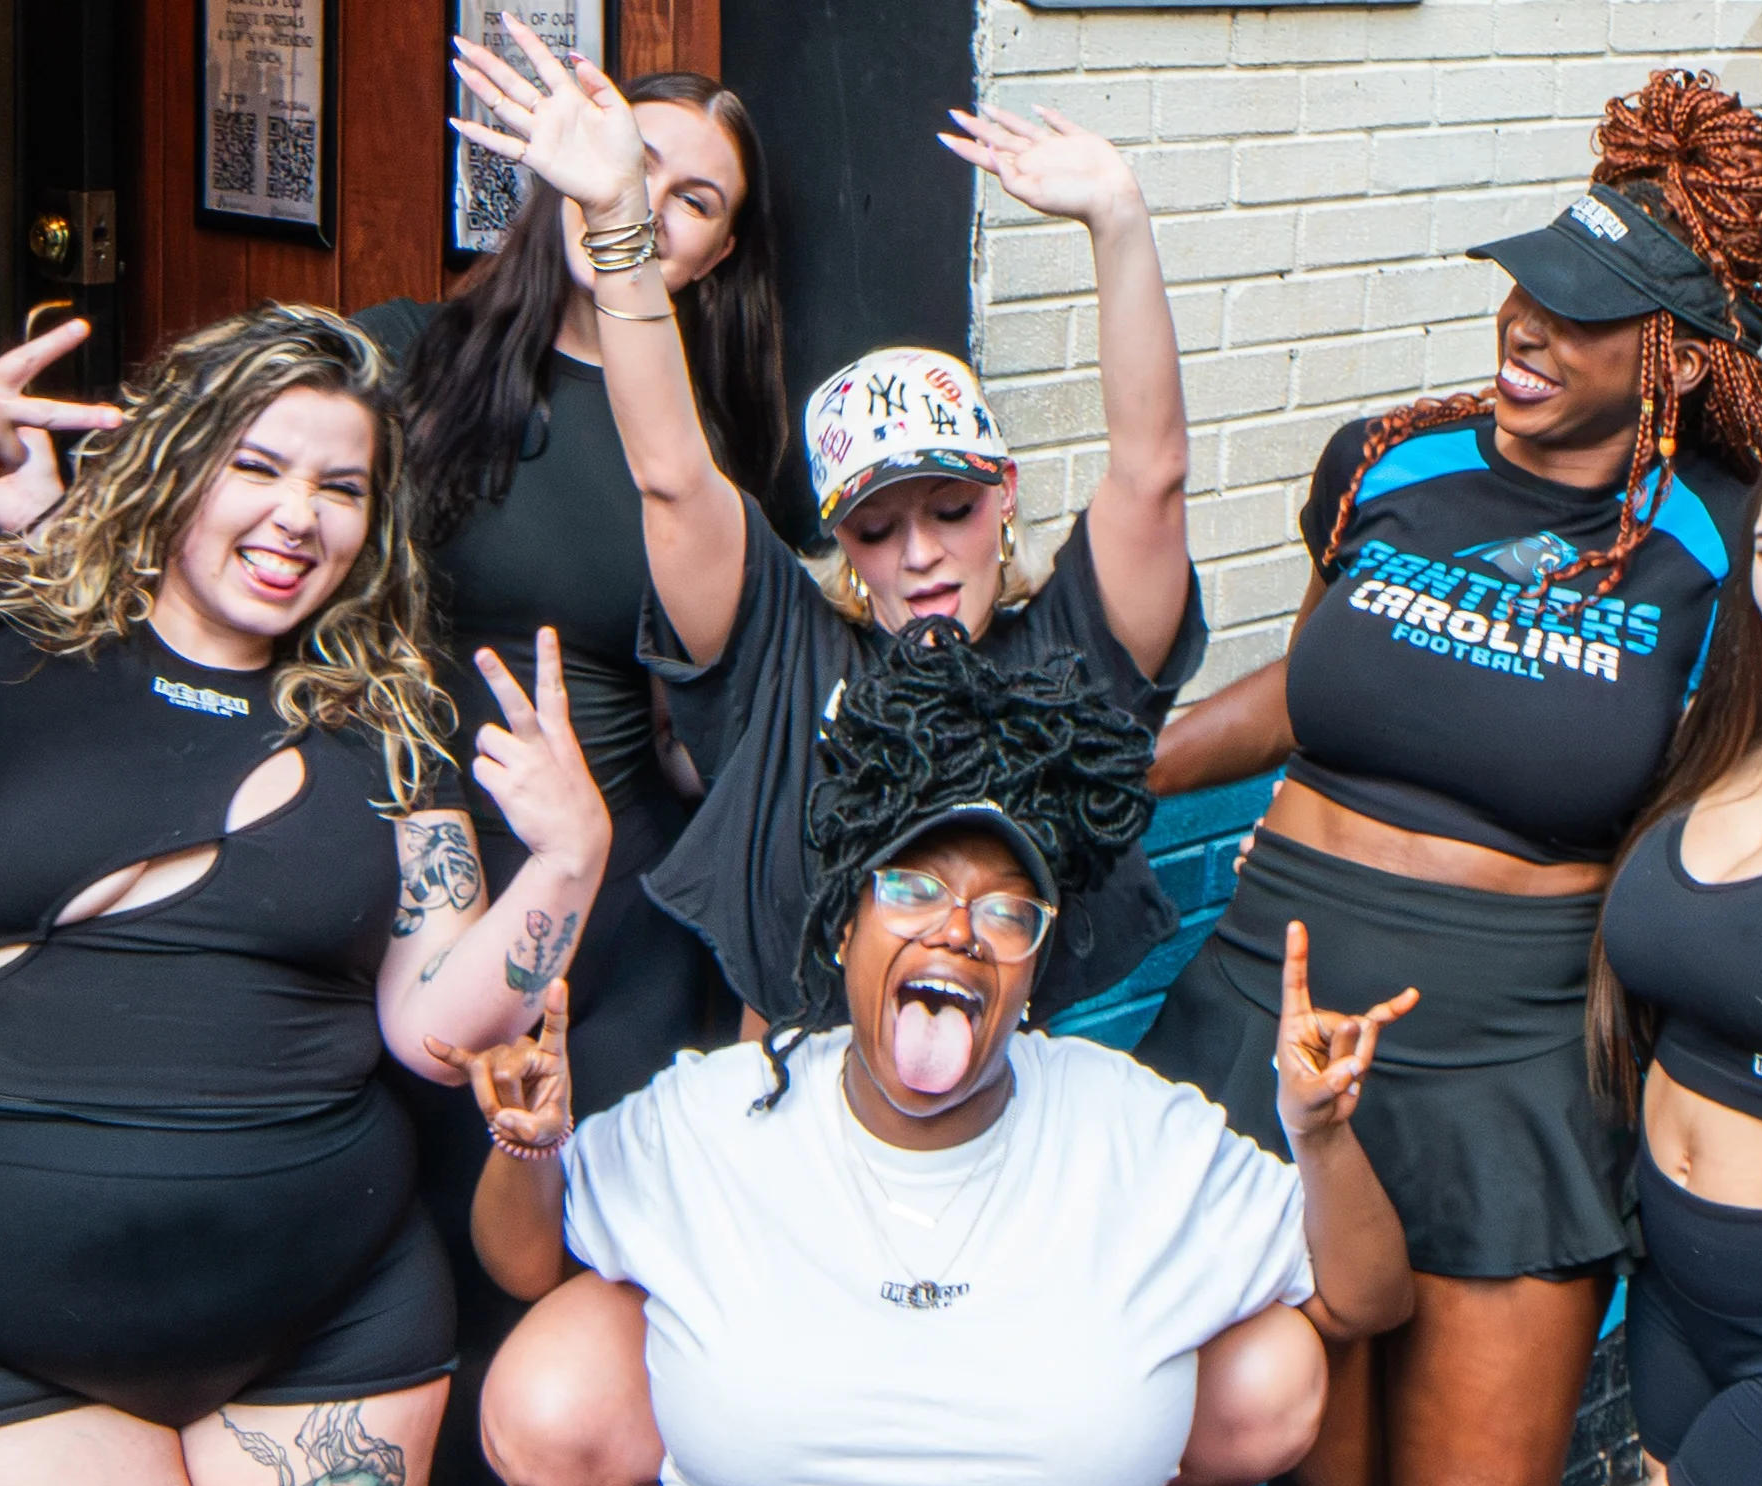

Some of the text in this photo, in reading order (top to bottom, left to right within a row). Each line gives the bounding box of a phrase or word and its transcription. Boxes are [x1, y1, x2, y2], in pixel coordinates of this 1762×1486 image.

[921, 394, 960, 436] LA
[1348, 539, 1661, 656] PANTHERS
[1348, 580, 1621, 682] CAROLINA
[1392, 622, 1545, 681] FOOTBALL
